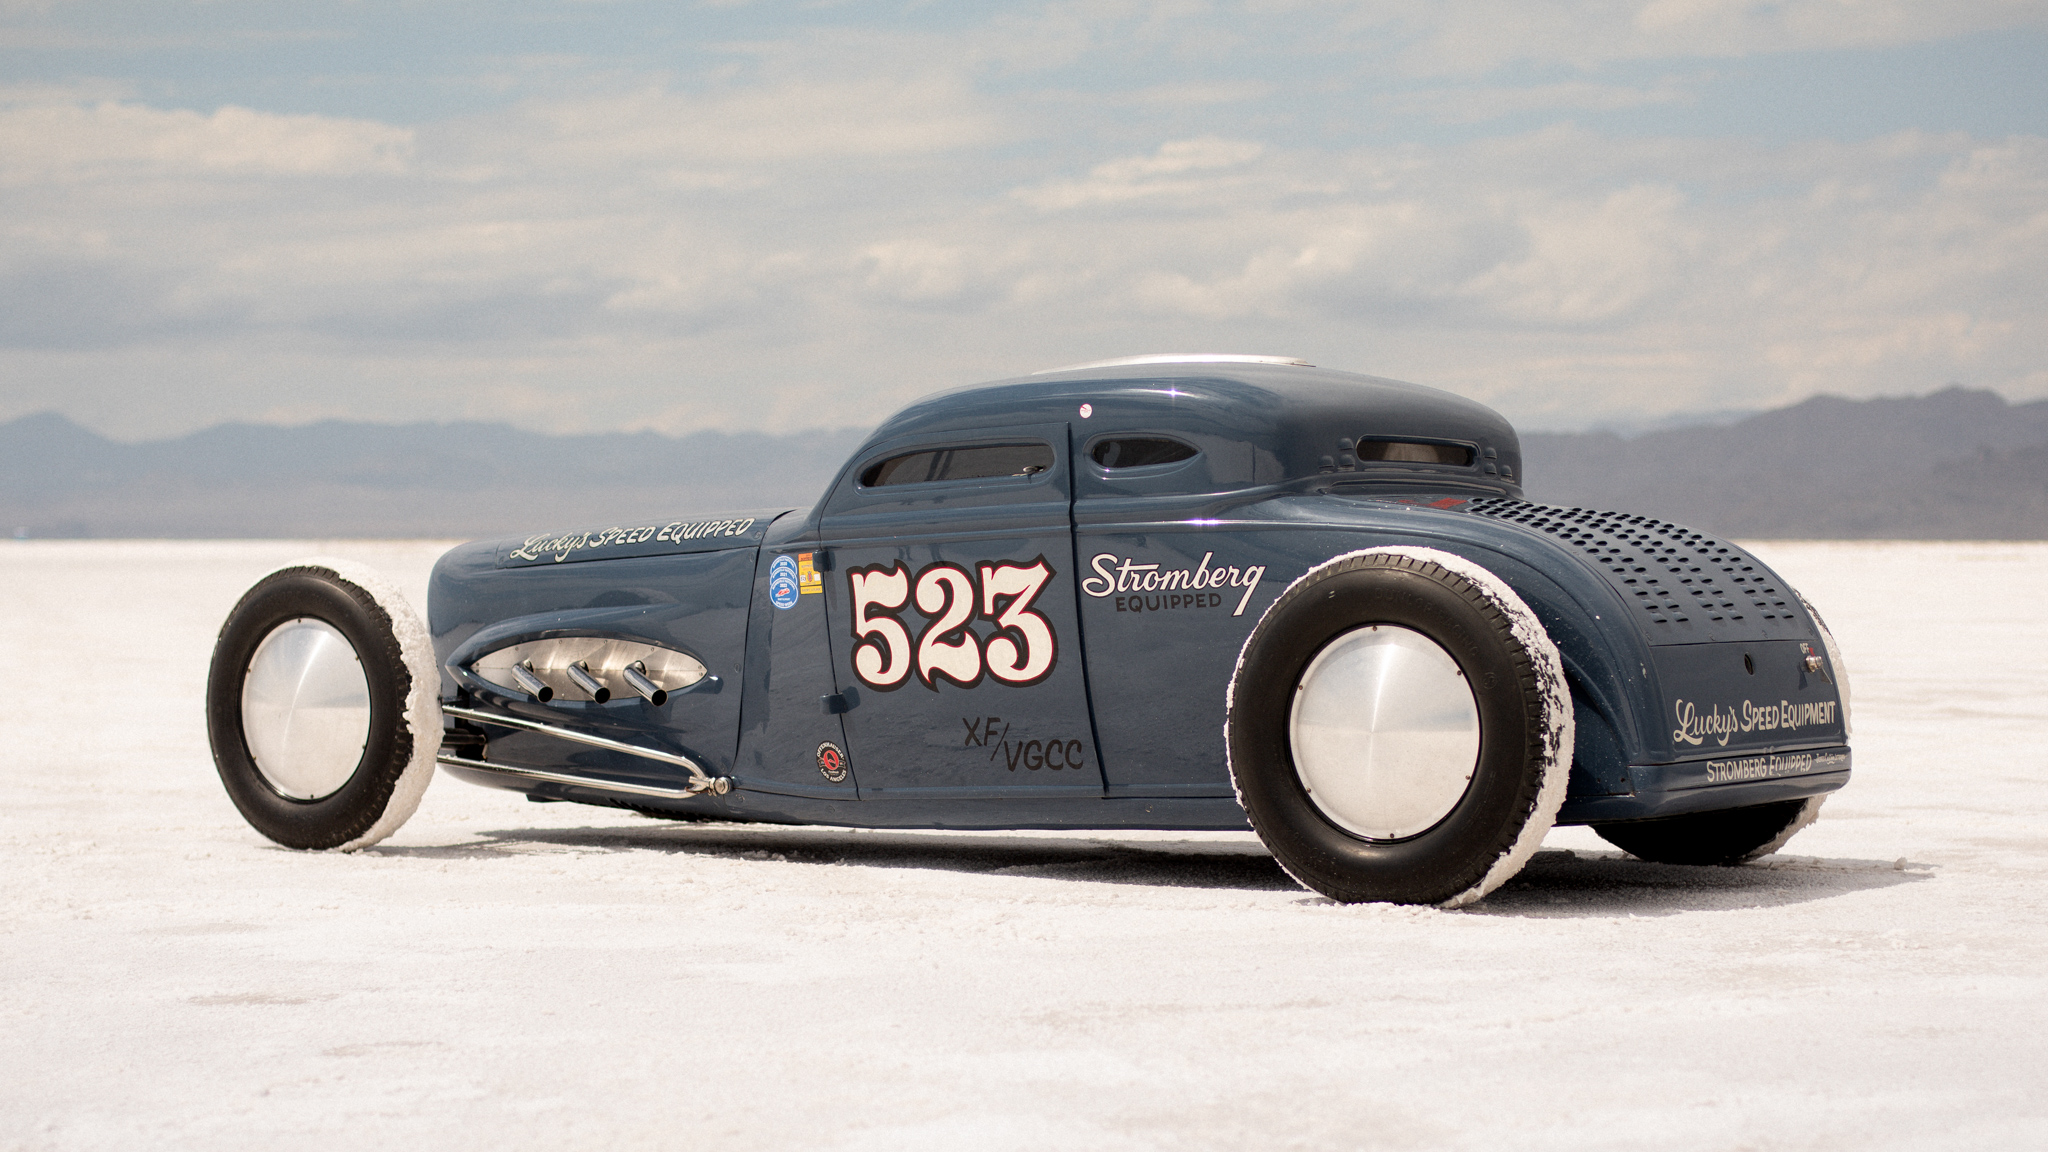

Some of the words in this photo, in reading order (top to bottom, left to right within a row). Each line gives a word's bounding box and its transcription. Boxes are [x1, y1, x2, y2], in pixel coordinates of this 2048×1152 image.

[509, 530, 591, 563] Lucky's
[588, 526, 656, 548] SPEED
[656, 517, 756, 545] EQUIPPED
[1082, 551, 1267, 618] Stromberg
[1115, 593, 1222, 613] EQUIPPED
[846, 553, 1058, 693] 523
[1673, 699, 1739, 746] Lucky's
[1740, 699, 1780, 732] SPEED
[1780, 700, 1836, 731] EQUIPMENT
[1706, 757, 1767, 782] STROMBERG
[1768, 753, 1813, 777] EQUIPPED
